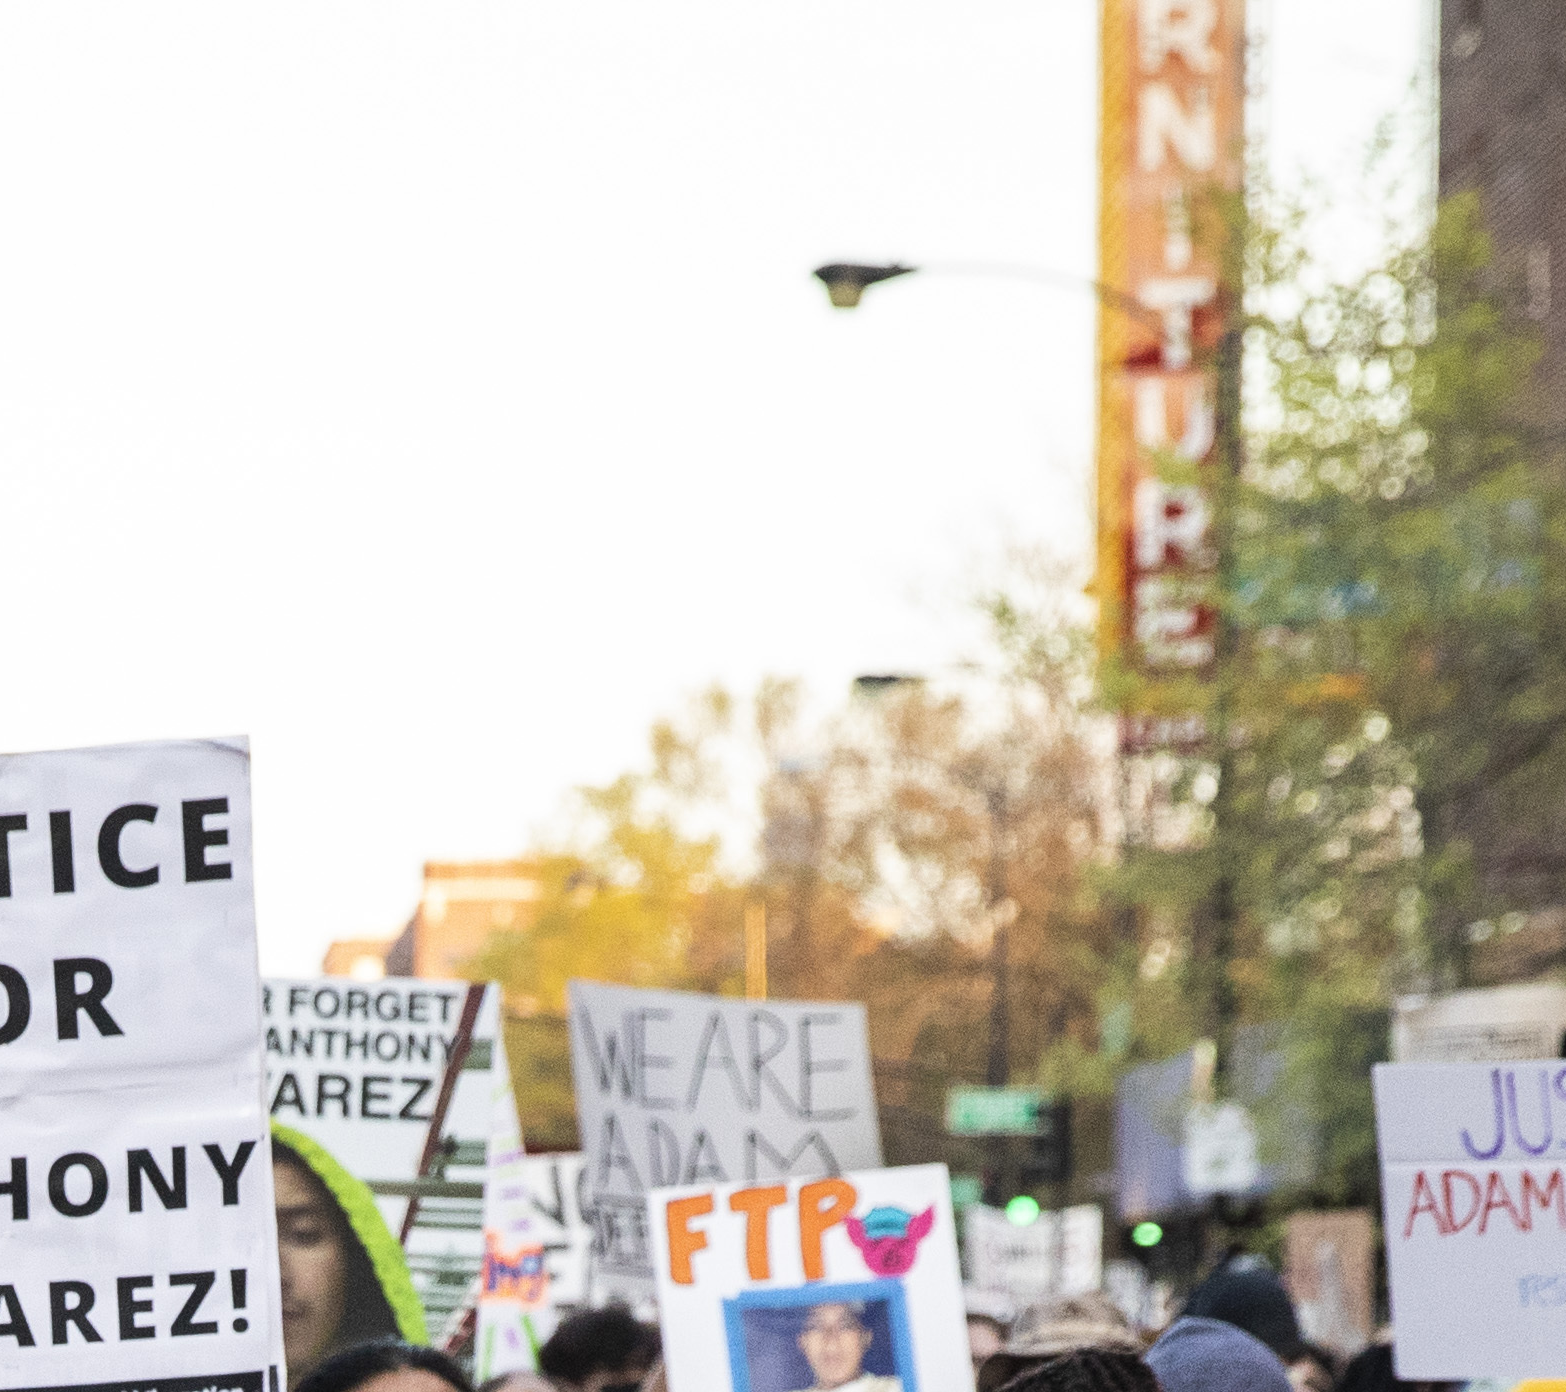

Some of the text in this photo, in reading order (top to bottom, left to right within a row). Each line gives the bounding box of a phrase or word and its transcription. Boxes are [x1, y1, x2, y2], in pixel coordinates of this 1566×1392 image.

[289, 988, 459, 1024] FORGET
[264, 1071, 436, 1122] AREZ
[665, 1177, 858, 1285] FTP
